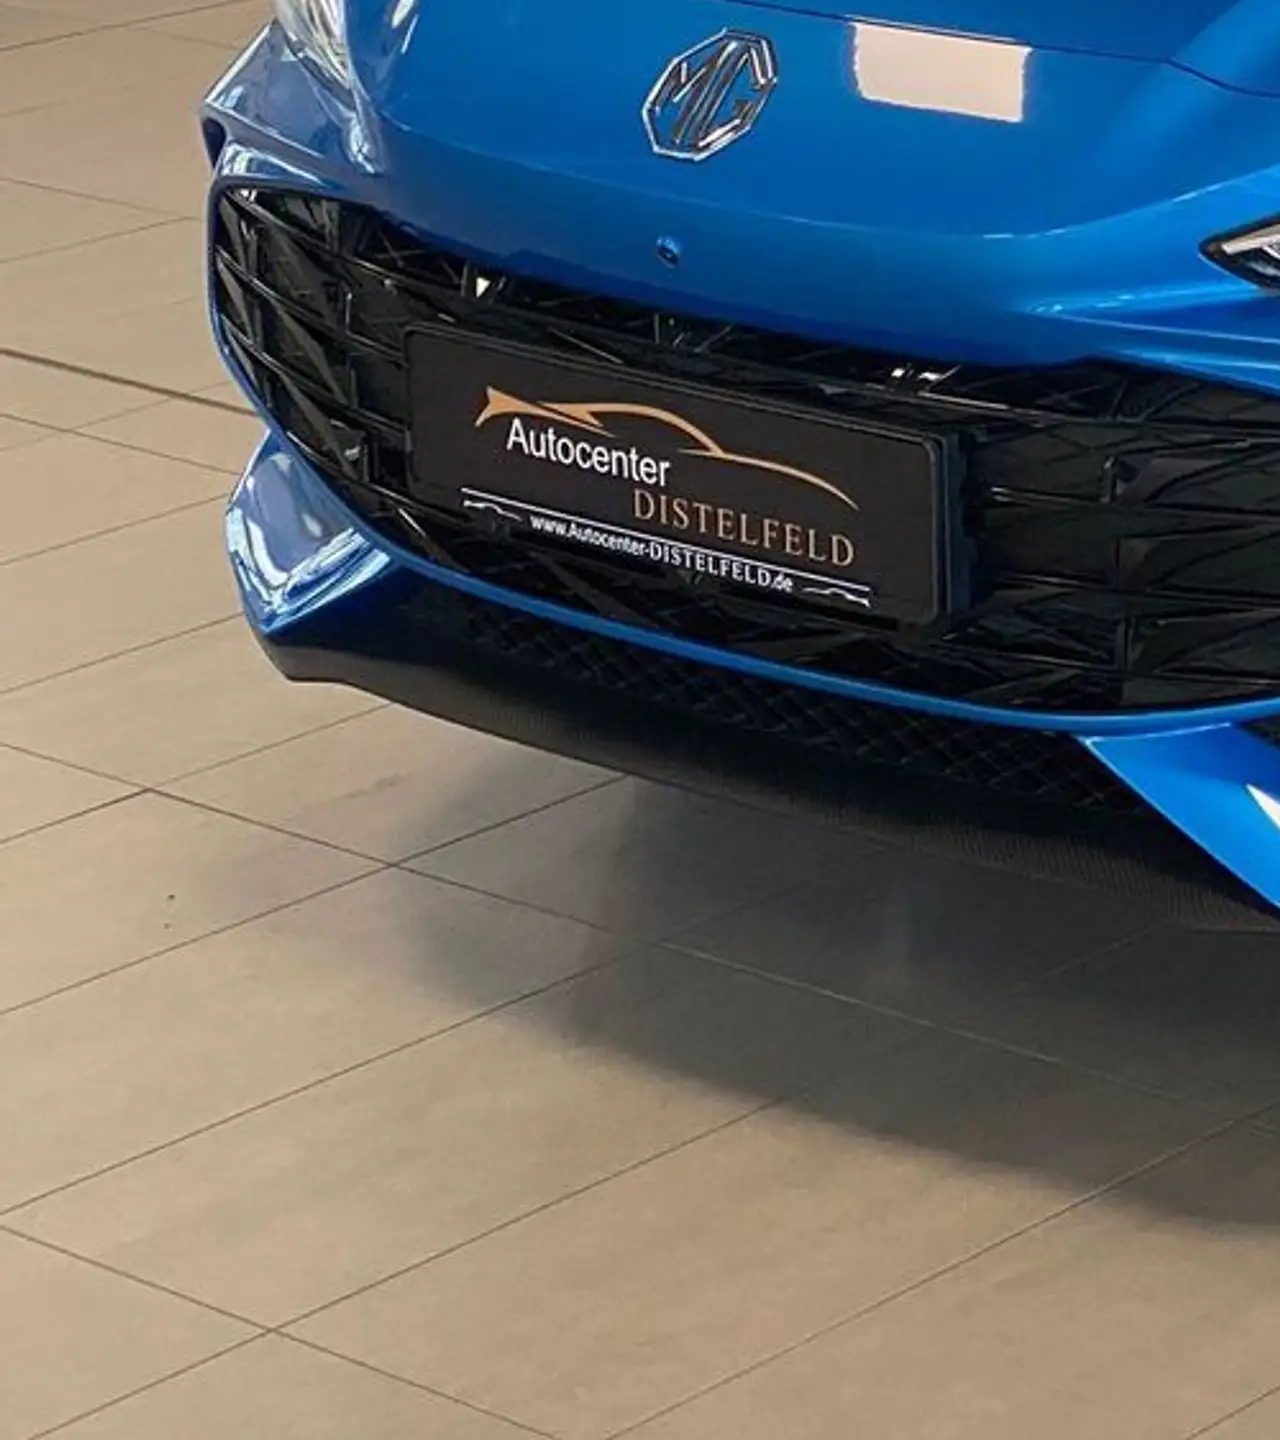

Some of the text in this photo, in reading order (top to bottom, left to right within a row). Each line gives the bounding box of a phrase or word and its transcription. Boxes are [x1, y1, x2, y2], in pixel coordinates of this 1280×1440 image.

[646, 29, 778, 160] MG
[506, 418, 670, 488] Autocenter
[528, 513, 794, 594] www.Autocenter-DISTELFELD.de
[632, 488, 855, 569] DISTELFELD
